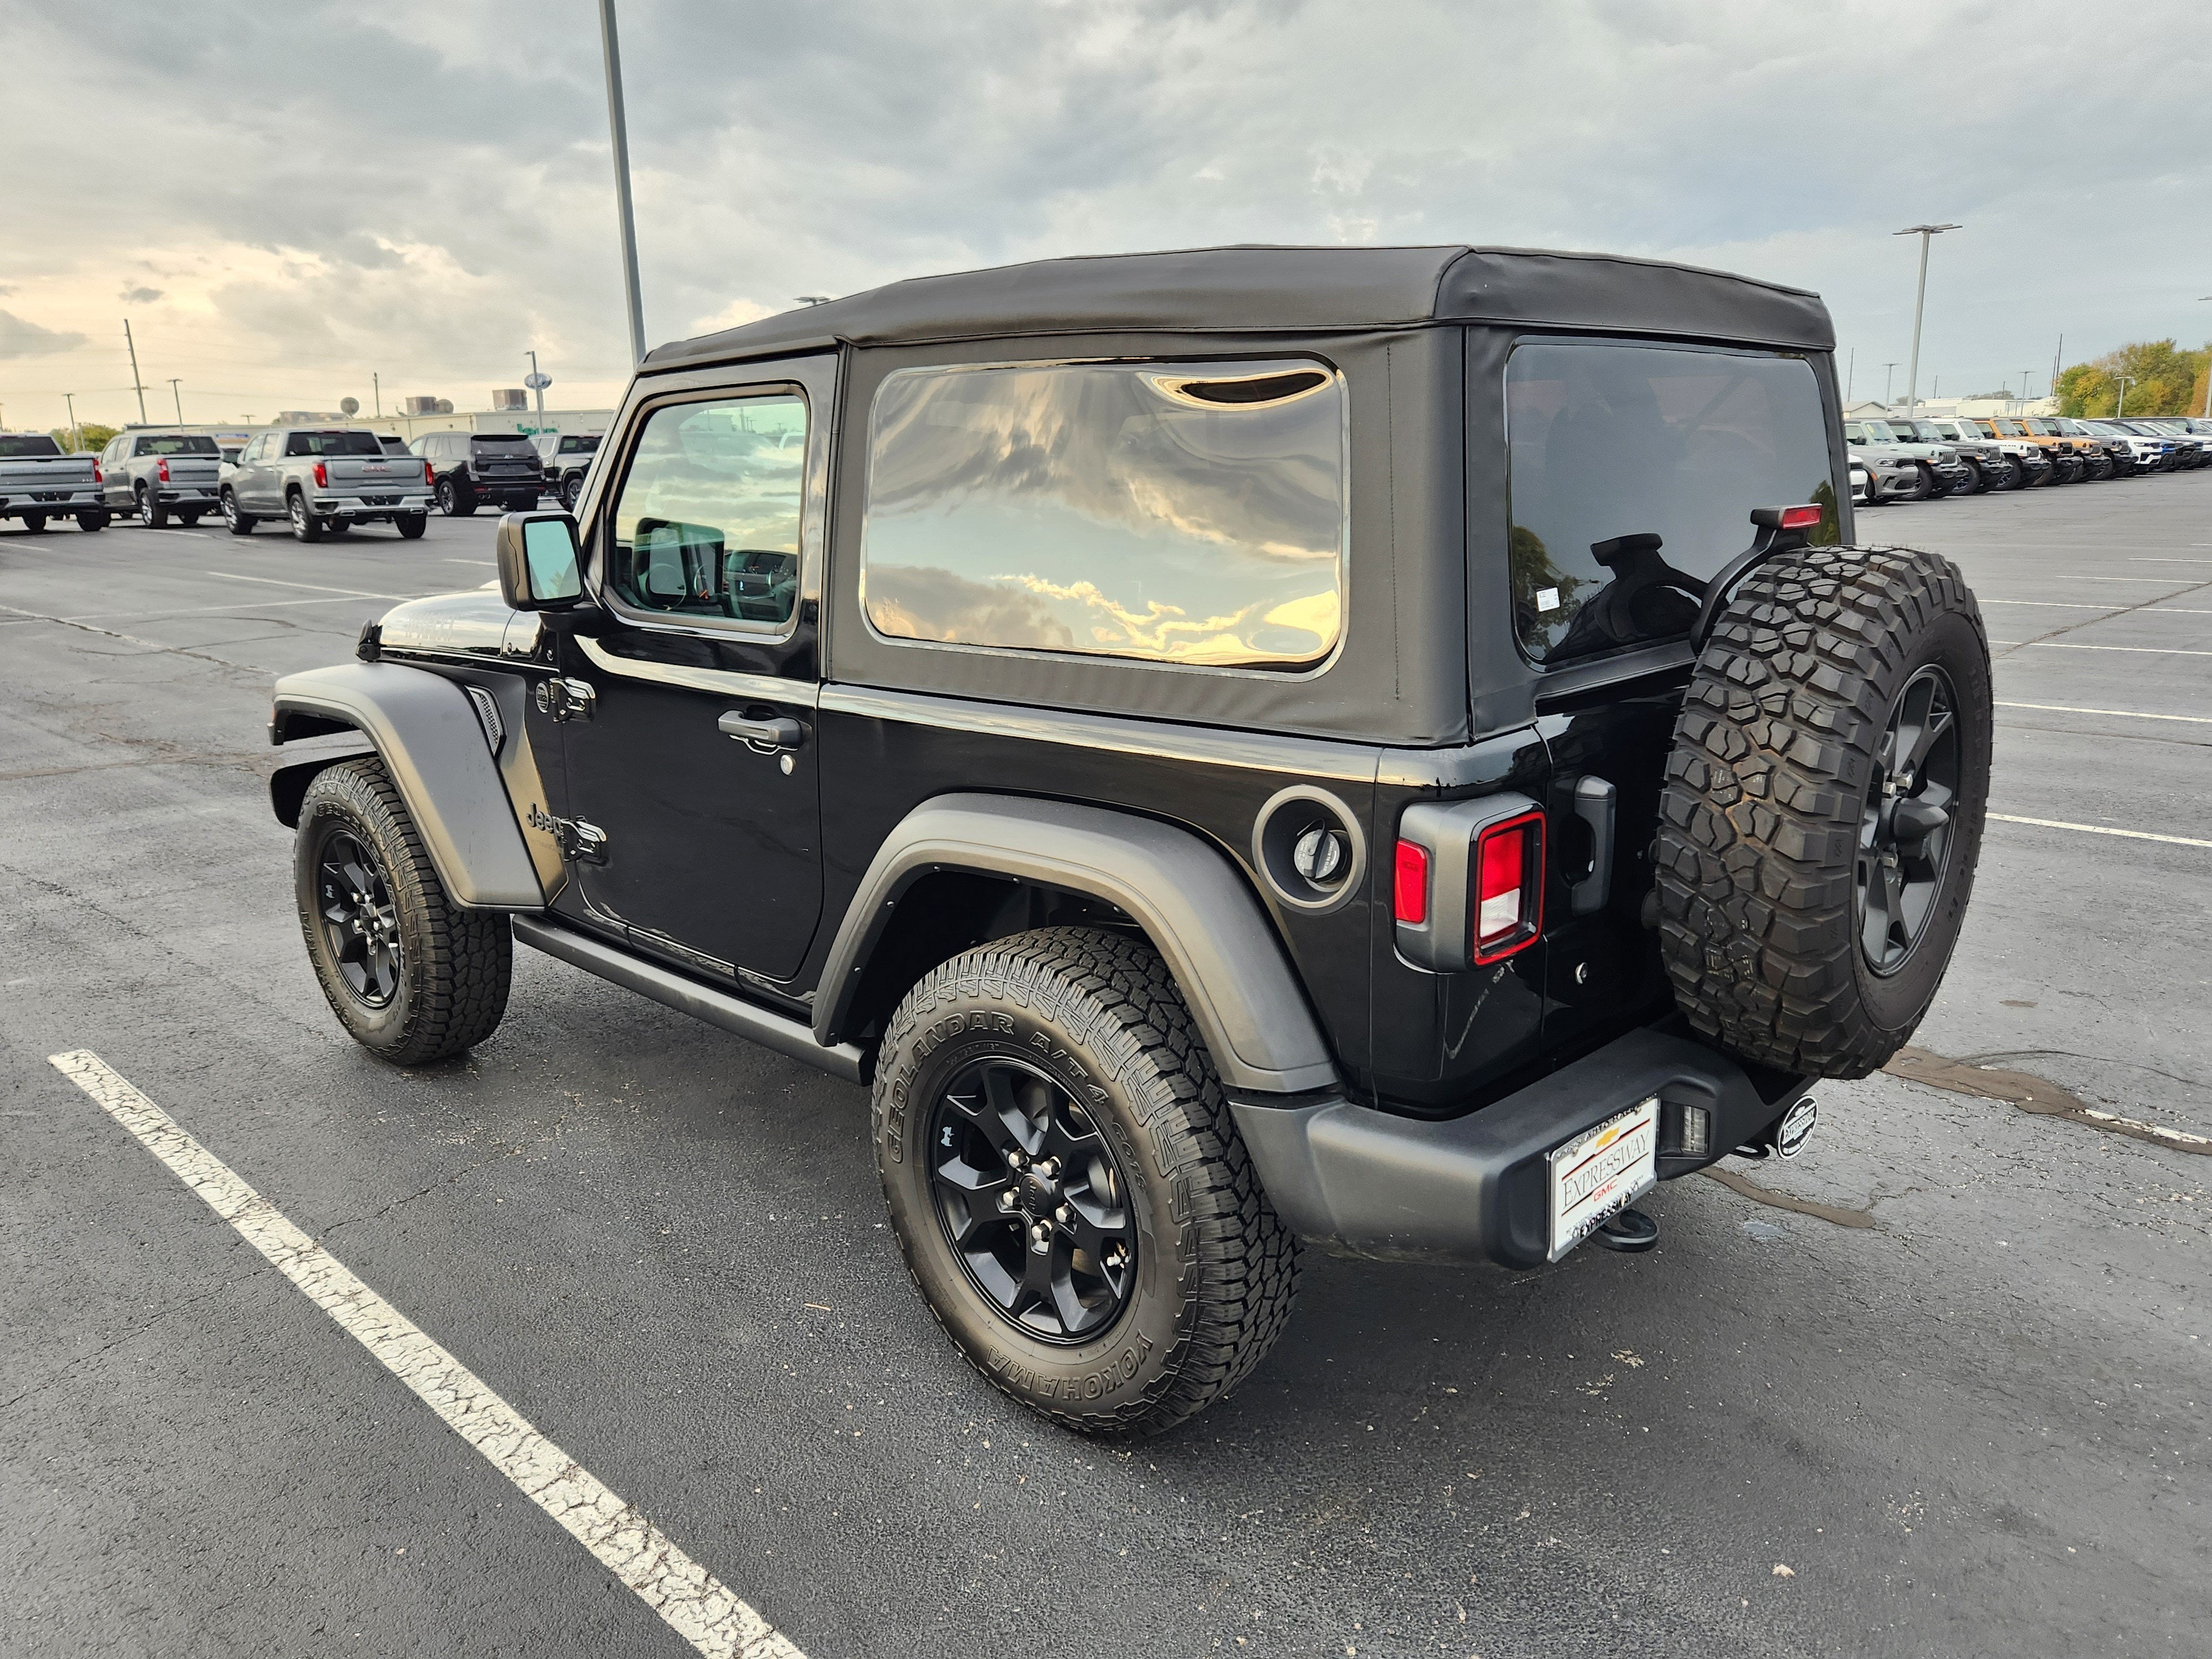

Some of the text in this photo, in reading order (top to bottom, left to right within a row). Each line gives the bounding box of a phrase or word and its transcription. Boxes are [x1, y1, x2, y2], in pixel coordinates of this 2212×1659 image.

[526, 802, 561, 839] Jeep
[888, 1010, 1015, 1164] GEOLANDAR
[1028, 1181, 1037, 1210] Jeep
[1563, 1129, 1650, 1211] EXPRESSWAY
[1593, 1178, 1618, 1202] GMC
[986, 1328, 1154, 1401] YOKOHAMA
